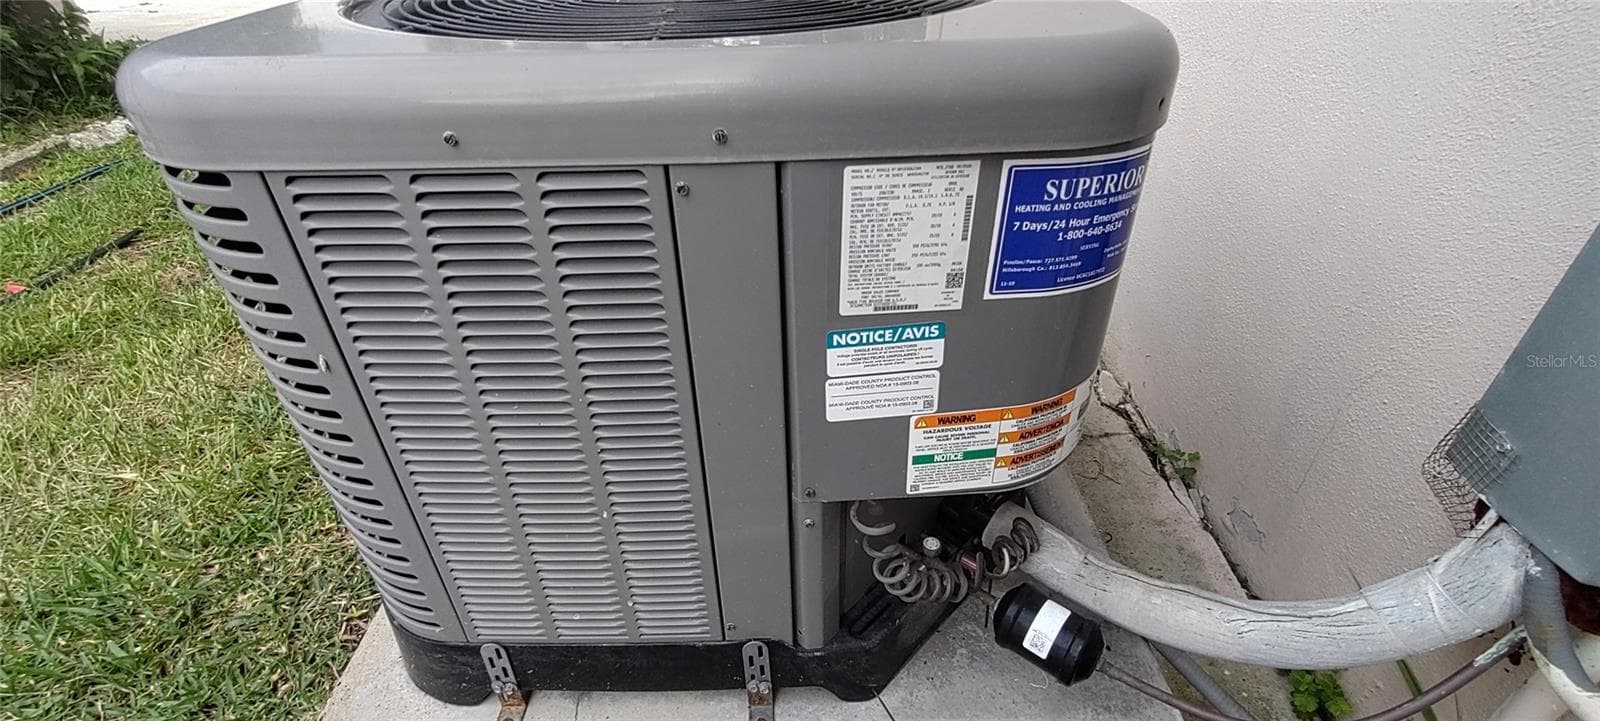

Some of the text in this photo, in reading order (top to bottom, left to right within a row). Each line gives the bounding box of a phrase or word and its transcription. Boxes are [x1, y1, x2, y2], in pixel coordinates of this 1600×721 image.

[1044, 165, 1145, 201] SUPERIOR
[1015, 204, 1051, 213] HEATING
[1052, 204, 1071, 212] AND
[1073, 198, 1107, 210] COOLING
[1012, 221, 1019, 231] 7
[1022, 222, 1066, 232] Days/24
[1068, 218, 1090, 228] Hour
[1093, 208, 1130, 224] Emergency
[1057, 220, 1122, 241] 1-800-640-8634
[832, 325, 940, 346] NOTICE/AVIS
[1031, 398, 1064, 415] WARNING
[937, 414, 977, 425] WARNING
[923, 426, 962, 435] HAZARDOUS
[933, 452, 963, 463] NOTICE
